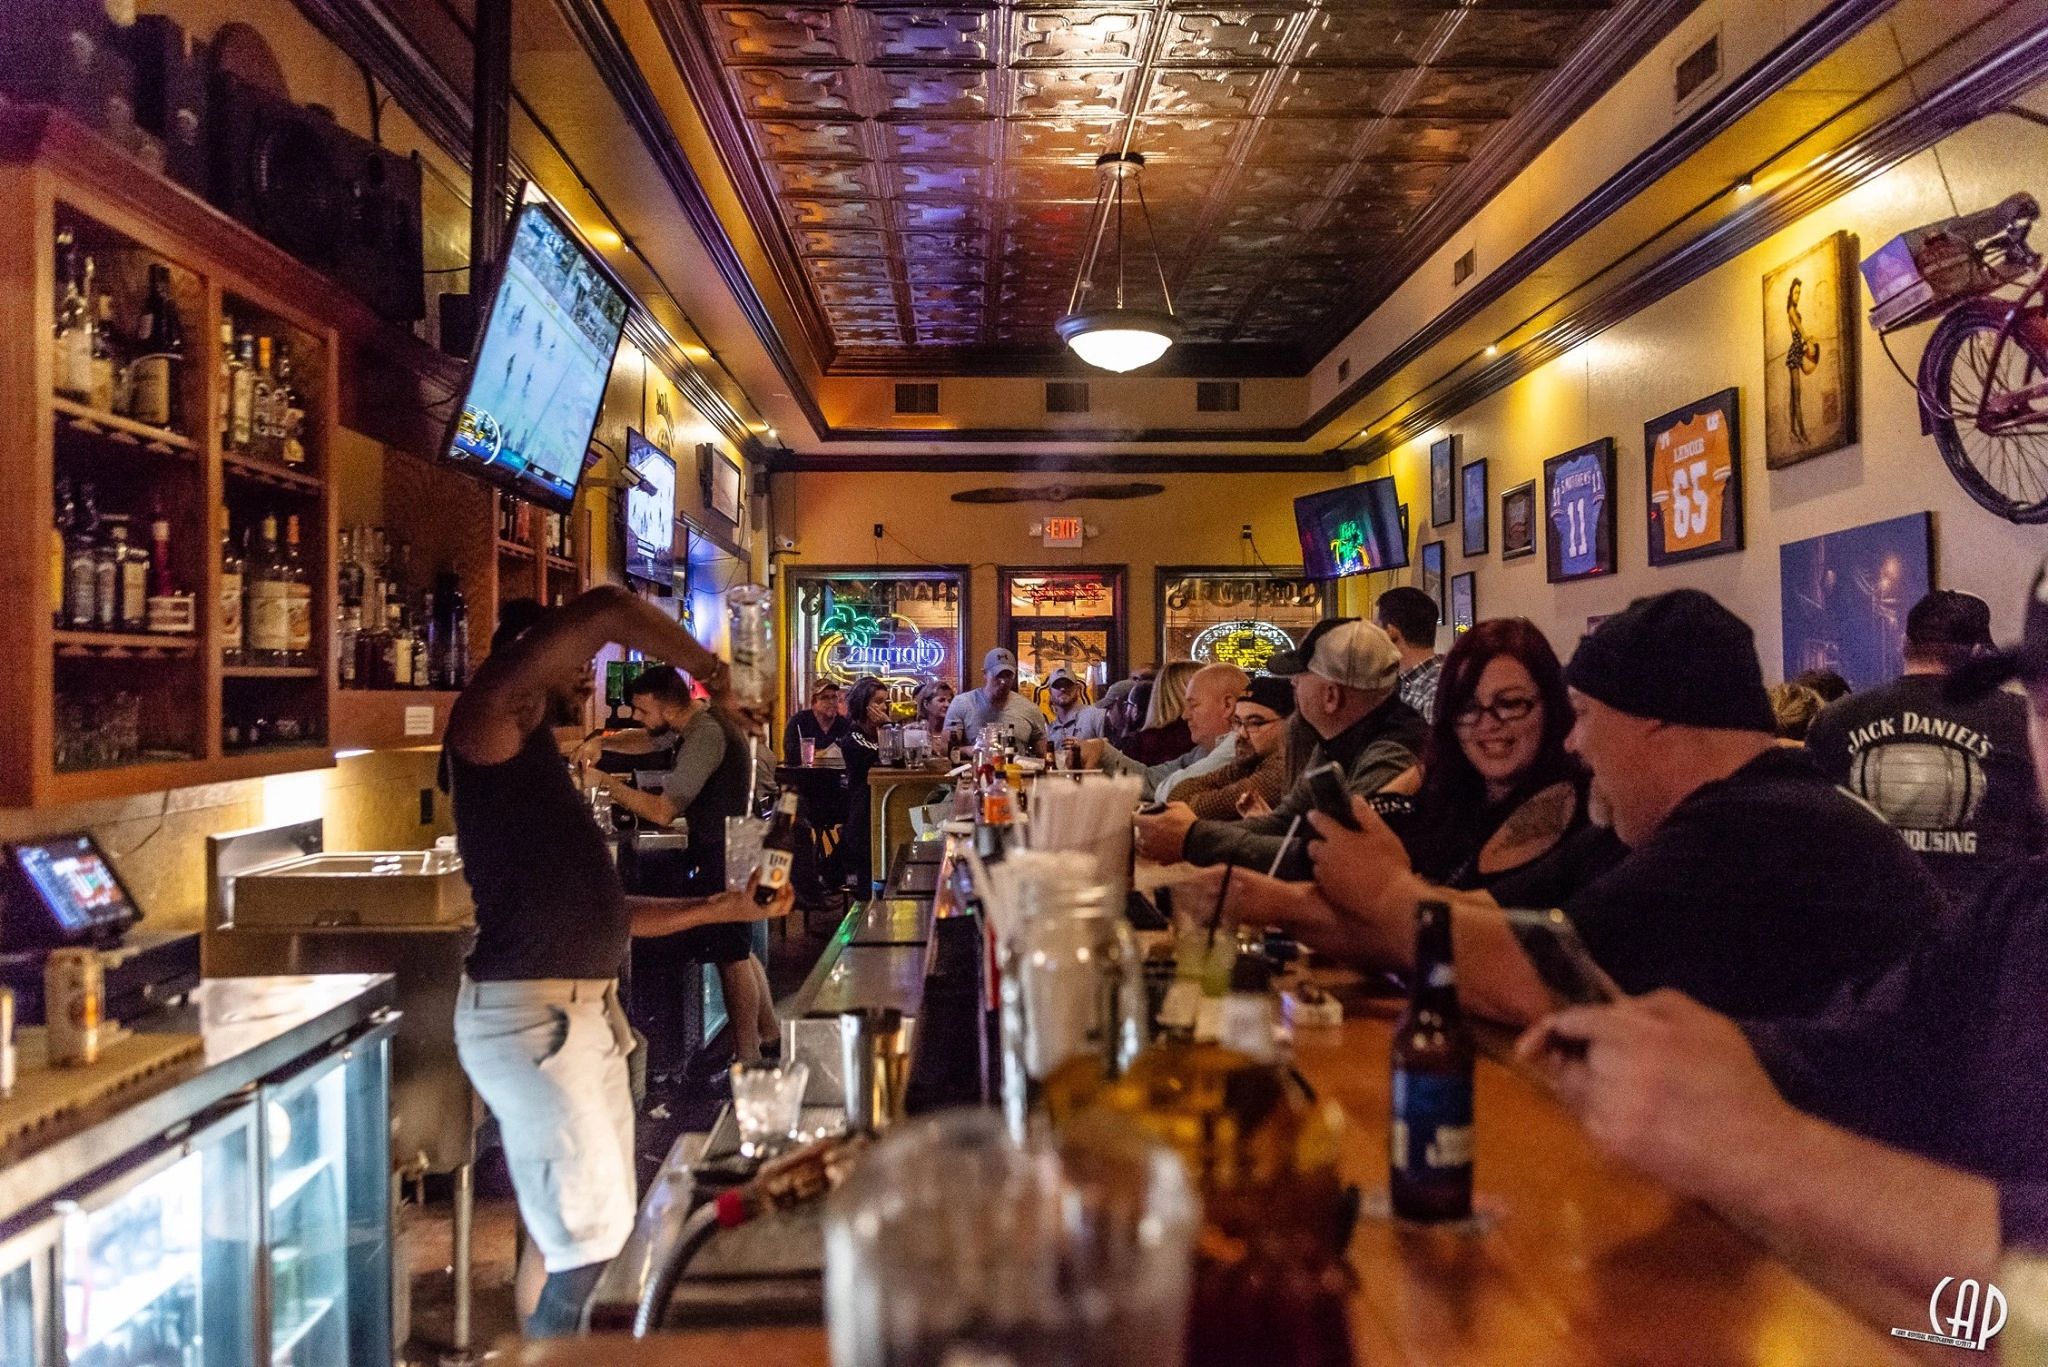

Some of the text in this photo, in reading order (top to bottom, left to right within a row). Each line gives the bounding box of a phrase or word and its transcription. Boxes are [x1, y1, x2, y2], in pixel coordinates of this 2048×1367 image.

[1673, 461, 1708, 539] 65
[1051, 519, 1077, 540] EXIT
[1567, 498, 1588, 558] 11
[1848, 711, 1994, 758] JACK DANIEL'S
